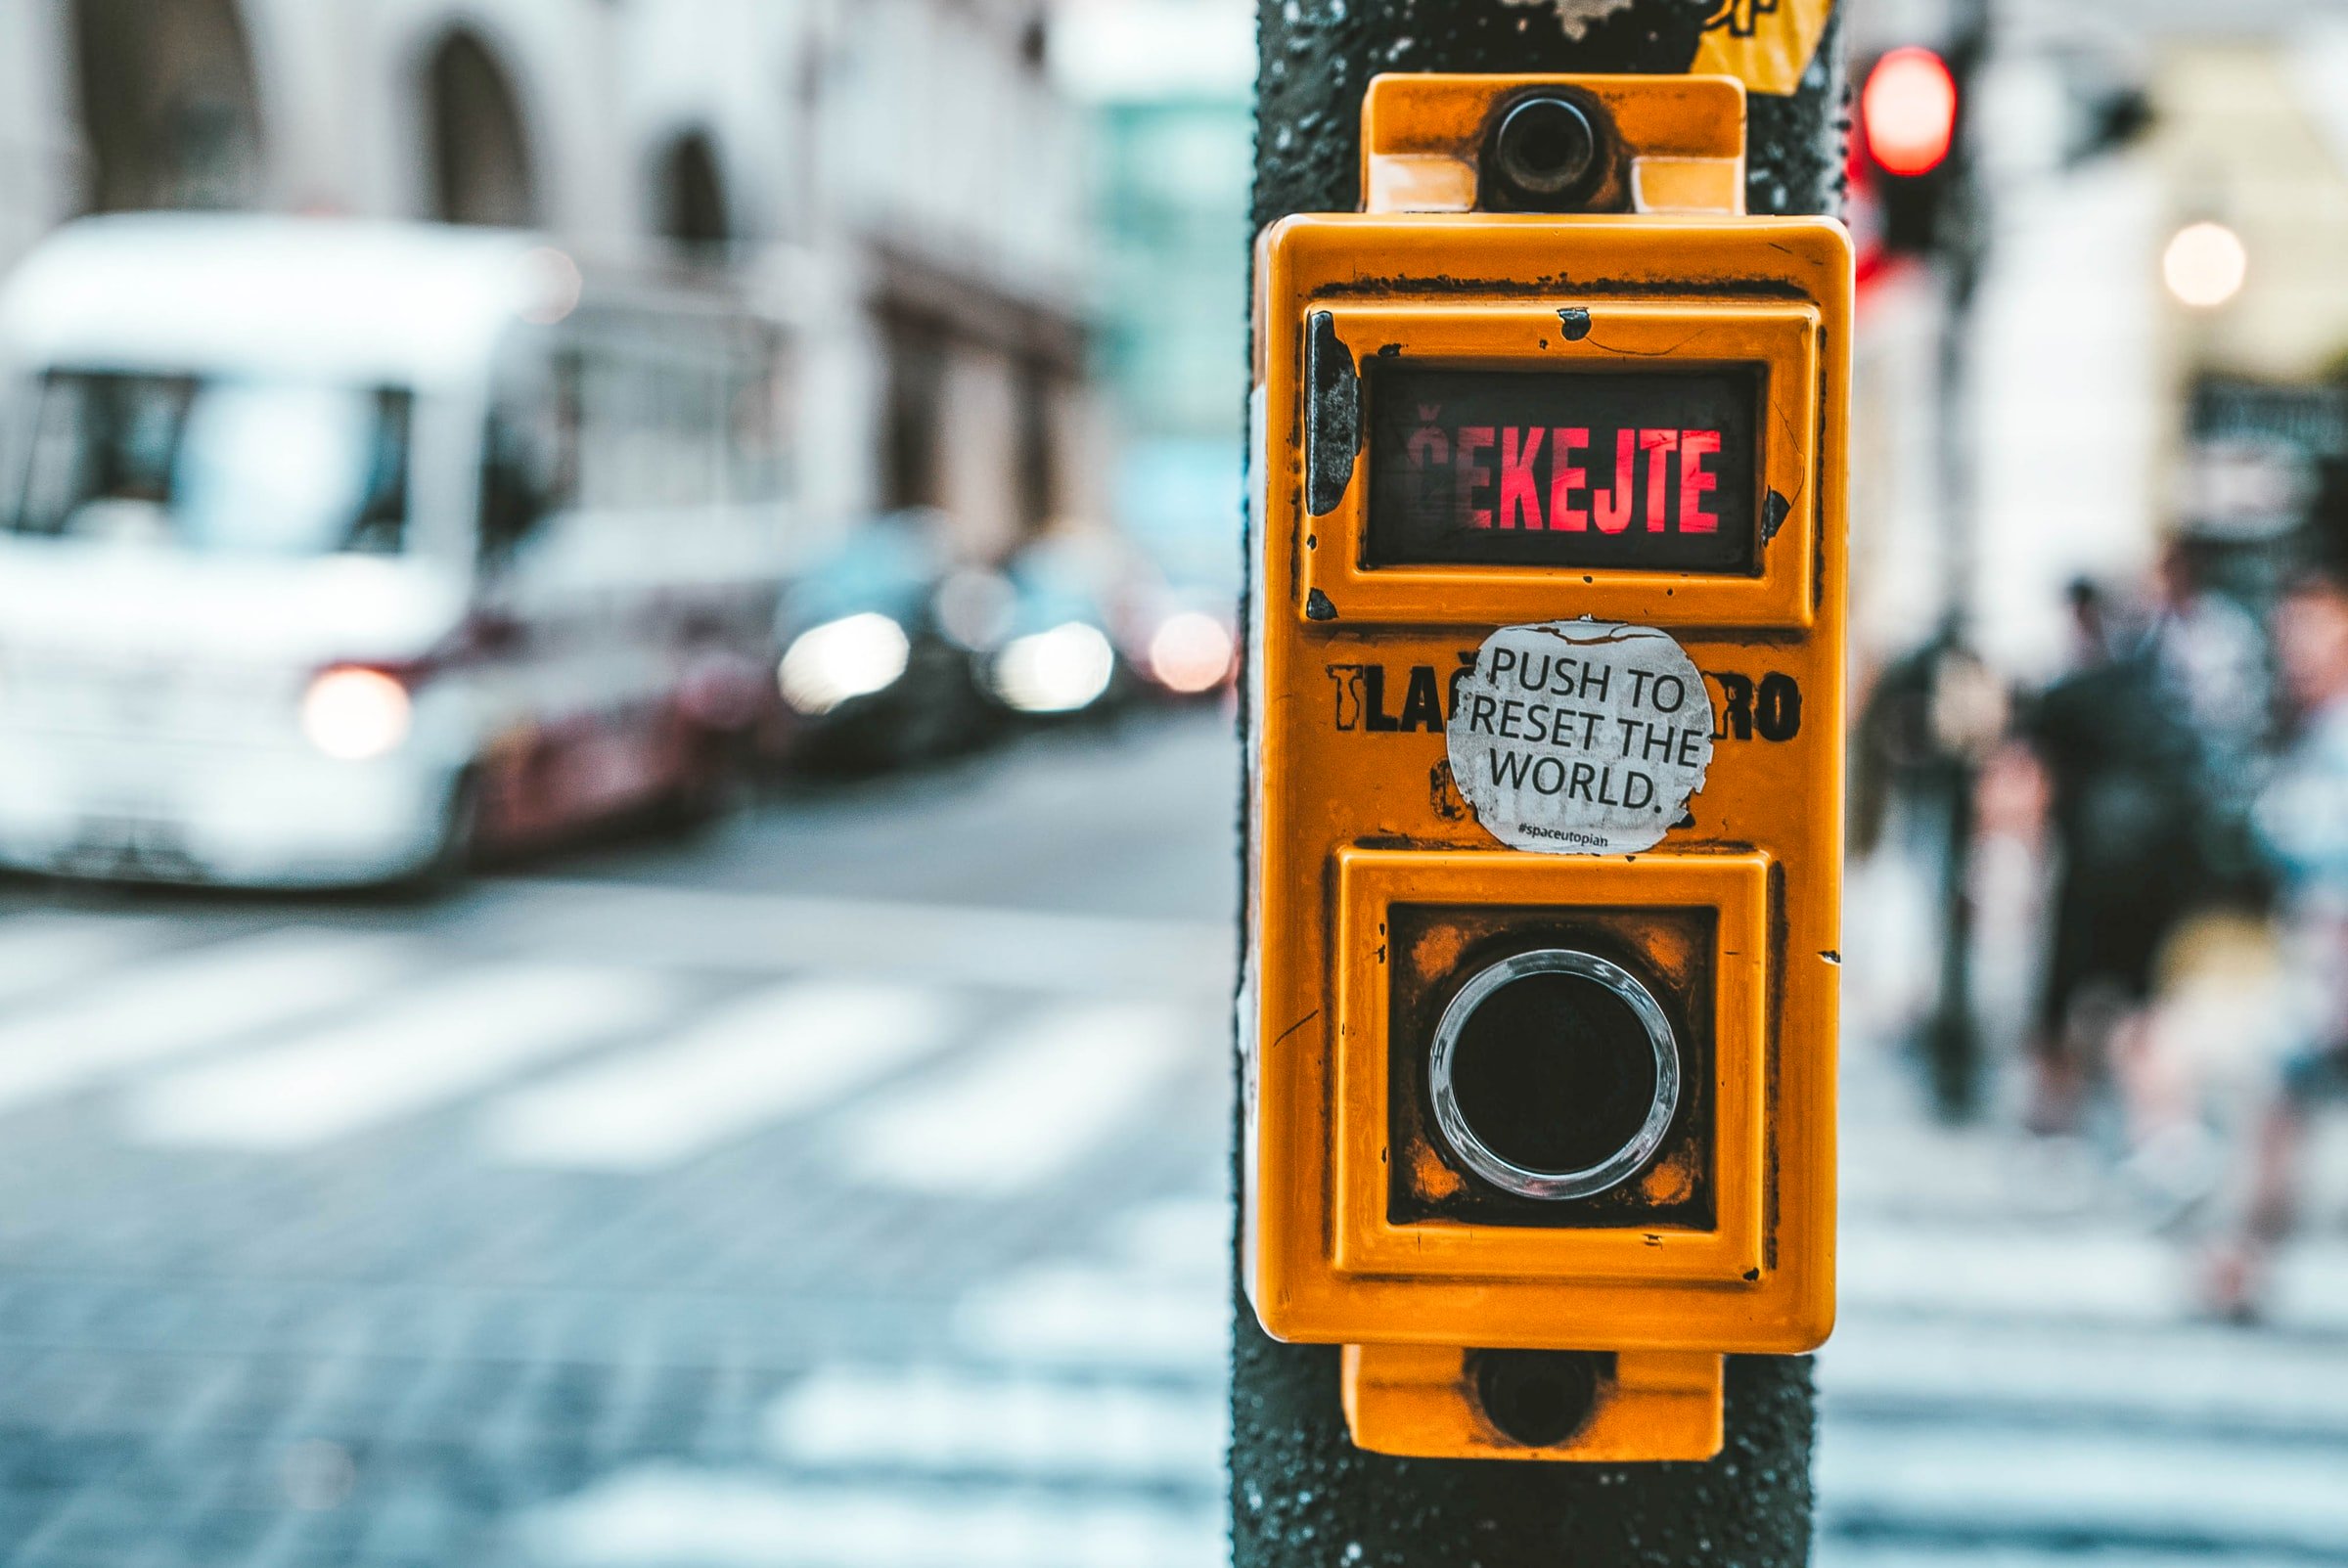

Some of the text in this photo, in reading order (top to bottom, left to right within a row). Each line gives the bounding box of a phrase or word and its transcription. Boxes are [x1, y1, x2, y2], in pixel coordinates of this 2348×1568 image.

[1407, 404, 1722, 534] ČEKEJTE
[1489, 647, 1686, 713] PUSH TO
[1699, 670, 1802, 741] RO
[1469, 694, 1703, 769] RESET THE
[1489, 747, 1662, 814] WORLD.
[1517, 823, 1608, 847] #spaceutopian
